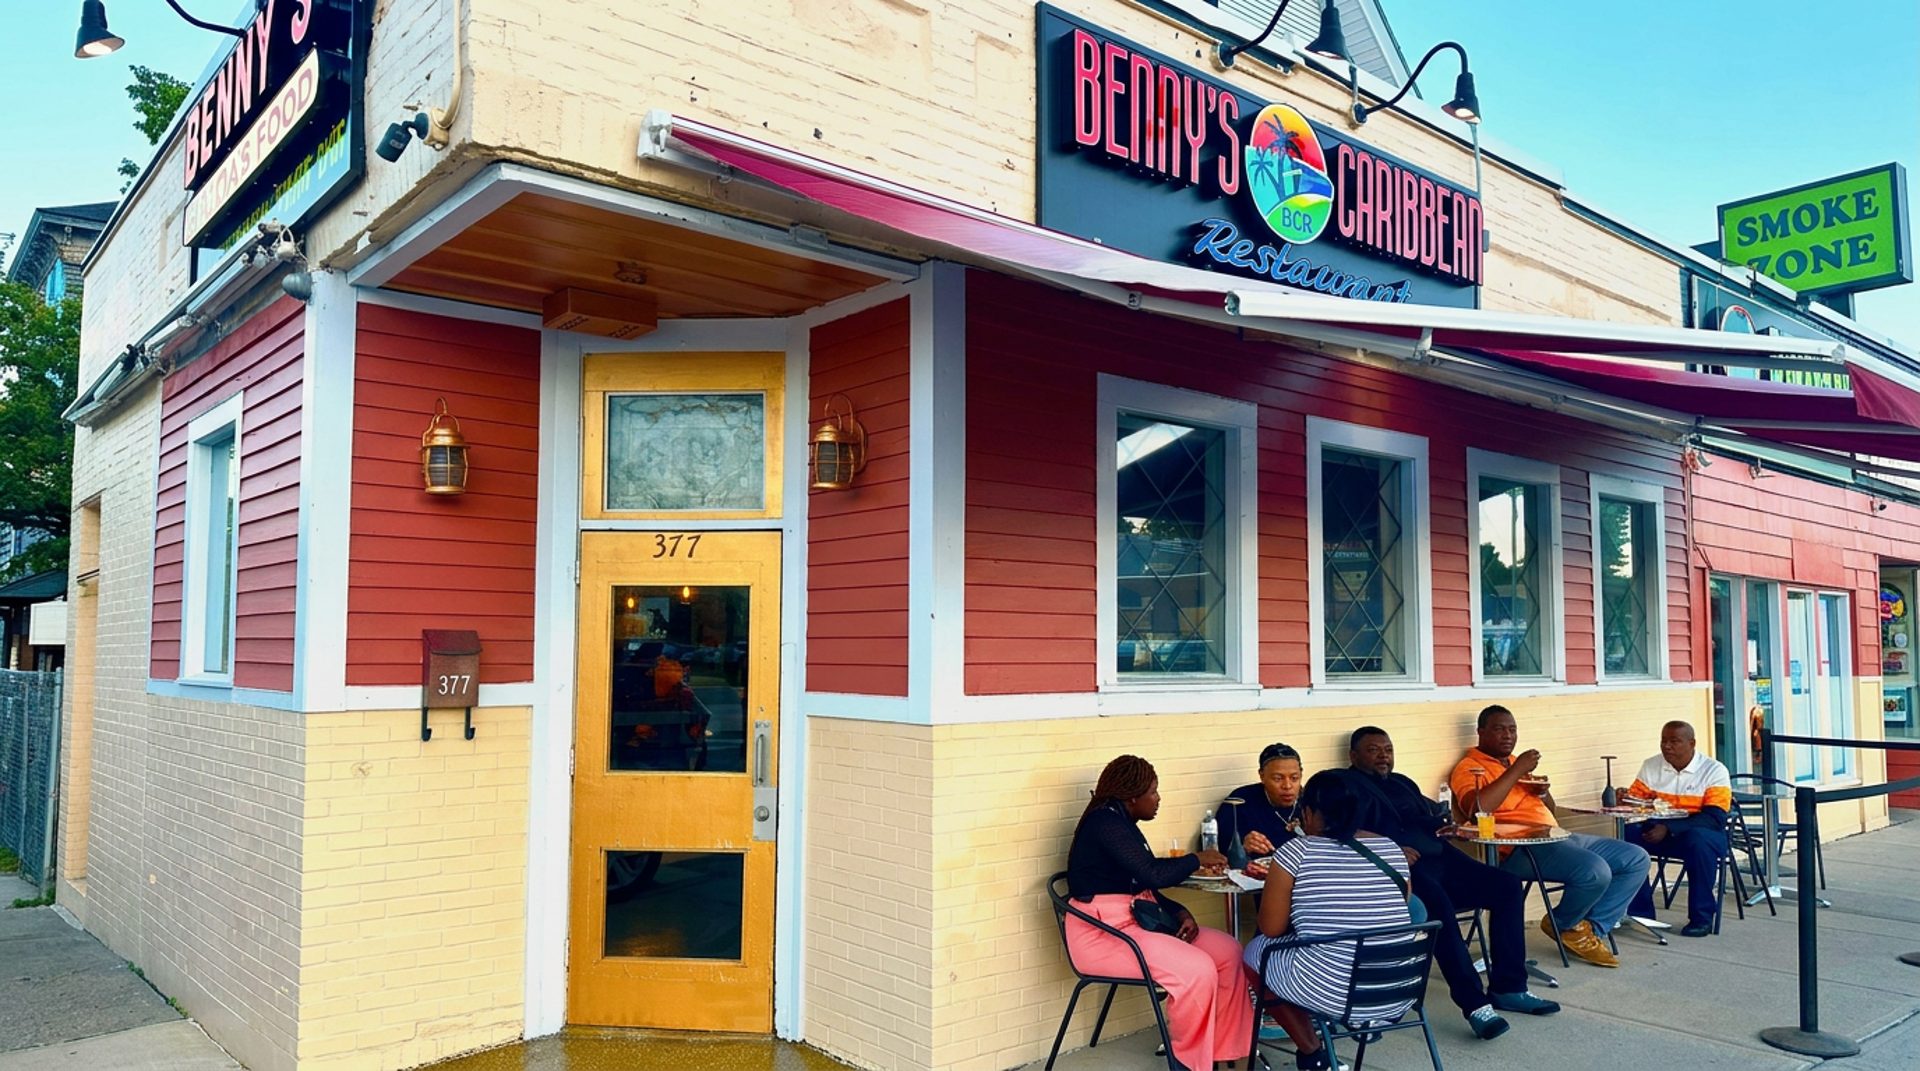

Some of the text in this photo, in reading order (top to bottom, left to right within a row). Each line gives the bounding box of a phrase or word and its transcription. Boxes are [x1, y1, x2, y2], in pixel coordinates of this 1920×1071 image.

[185, 0, 312, 189] BENNY
[256, 67, 312, 161] FOOD
[1074, 28, 1485, 287] BENNY'S CARIBBEAN
[1281, 207, 1313, 234] BCR
[1736, 187, 1879, 247] SMOKE
[652, 533, 701, 559] 377
[438, 674, 471, 695] 377
